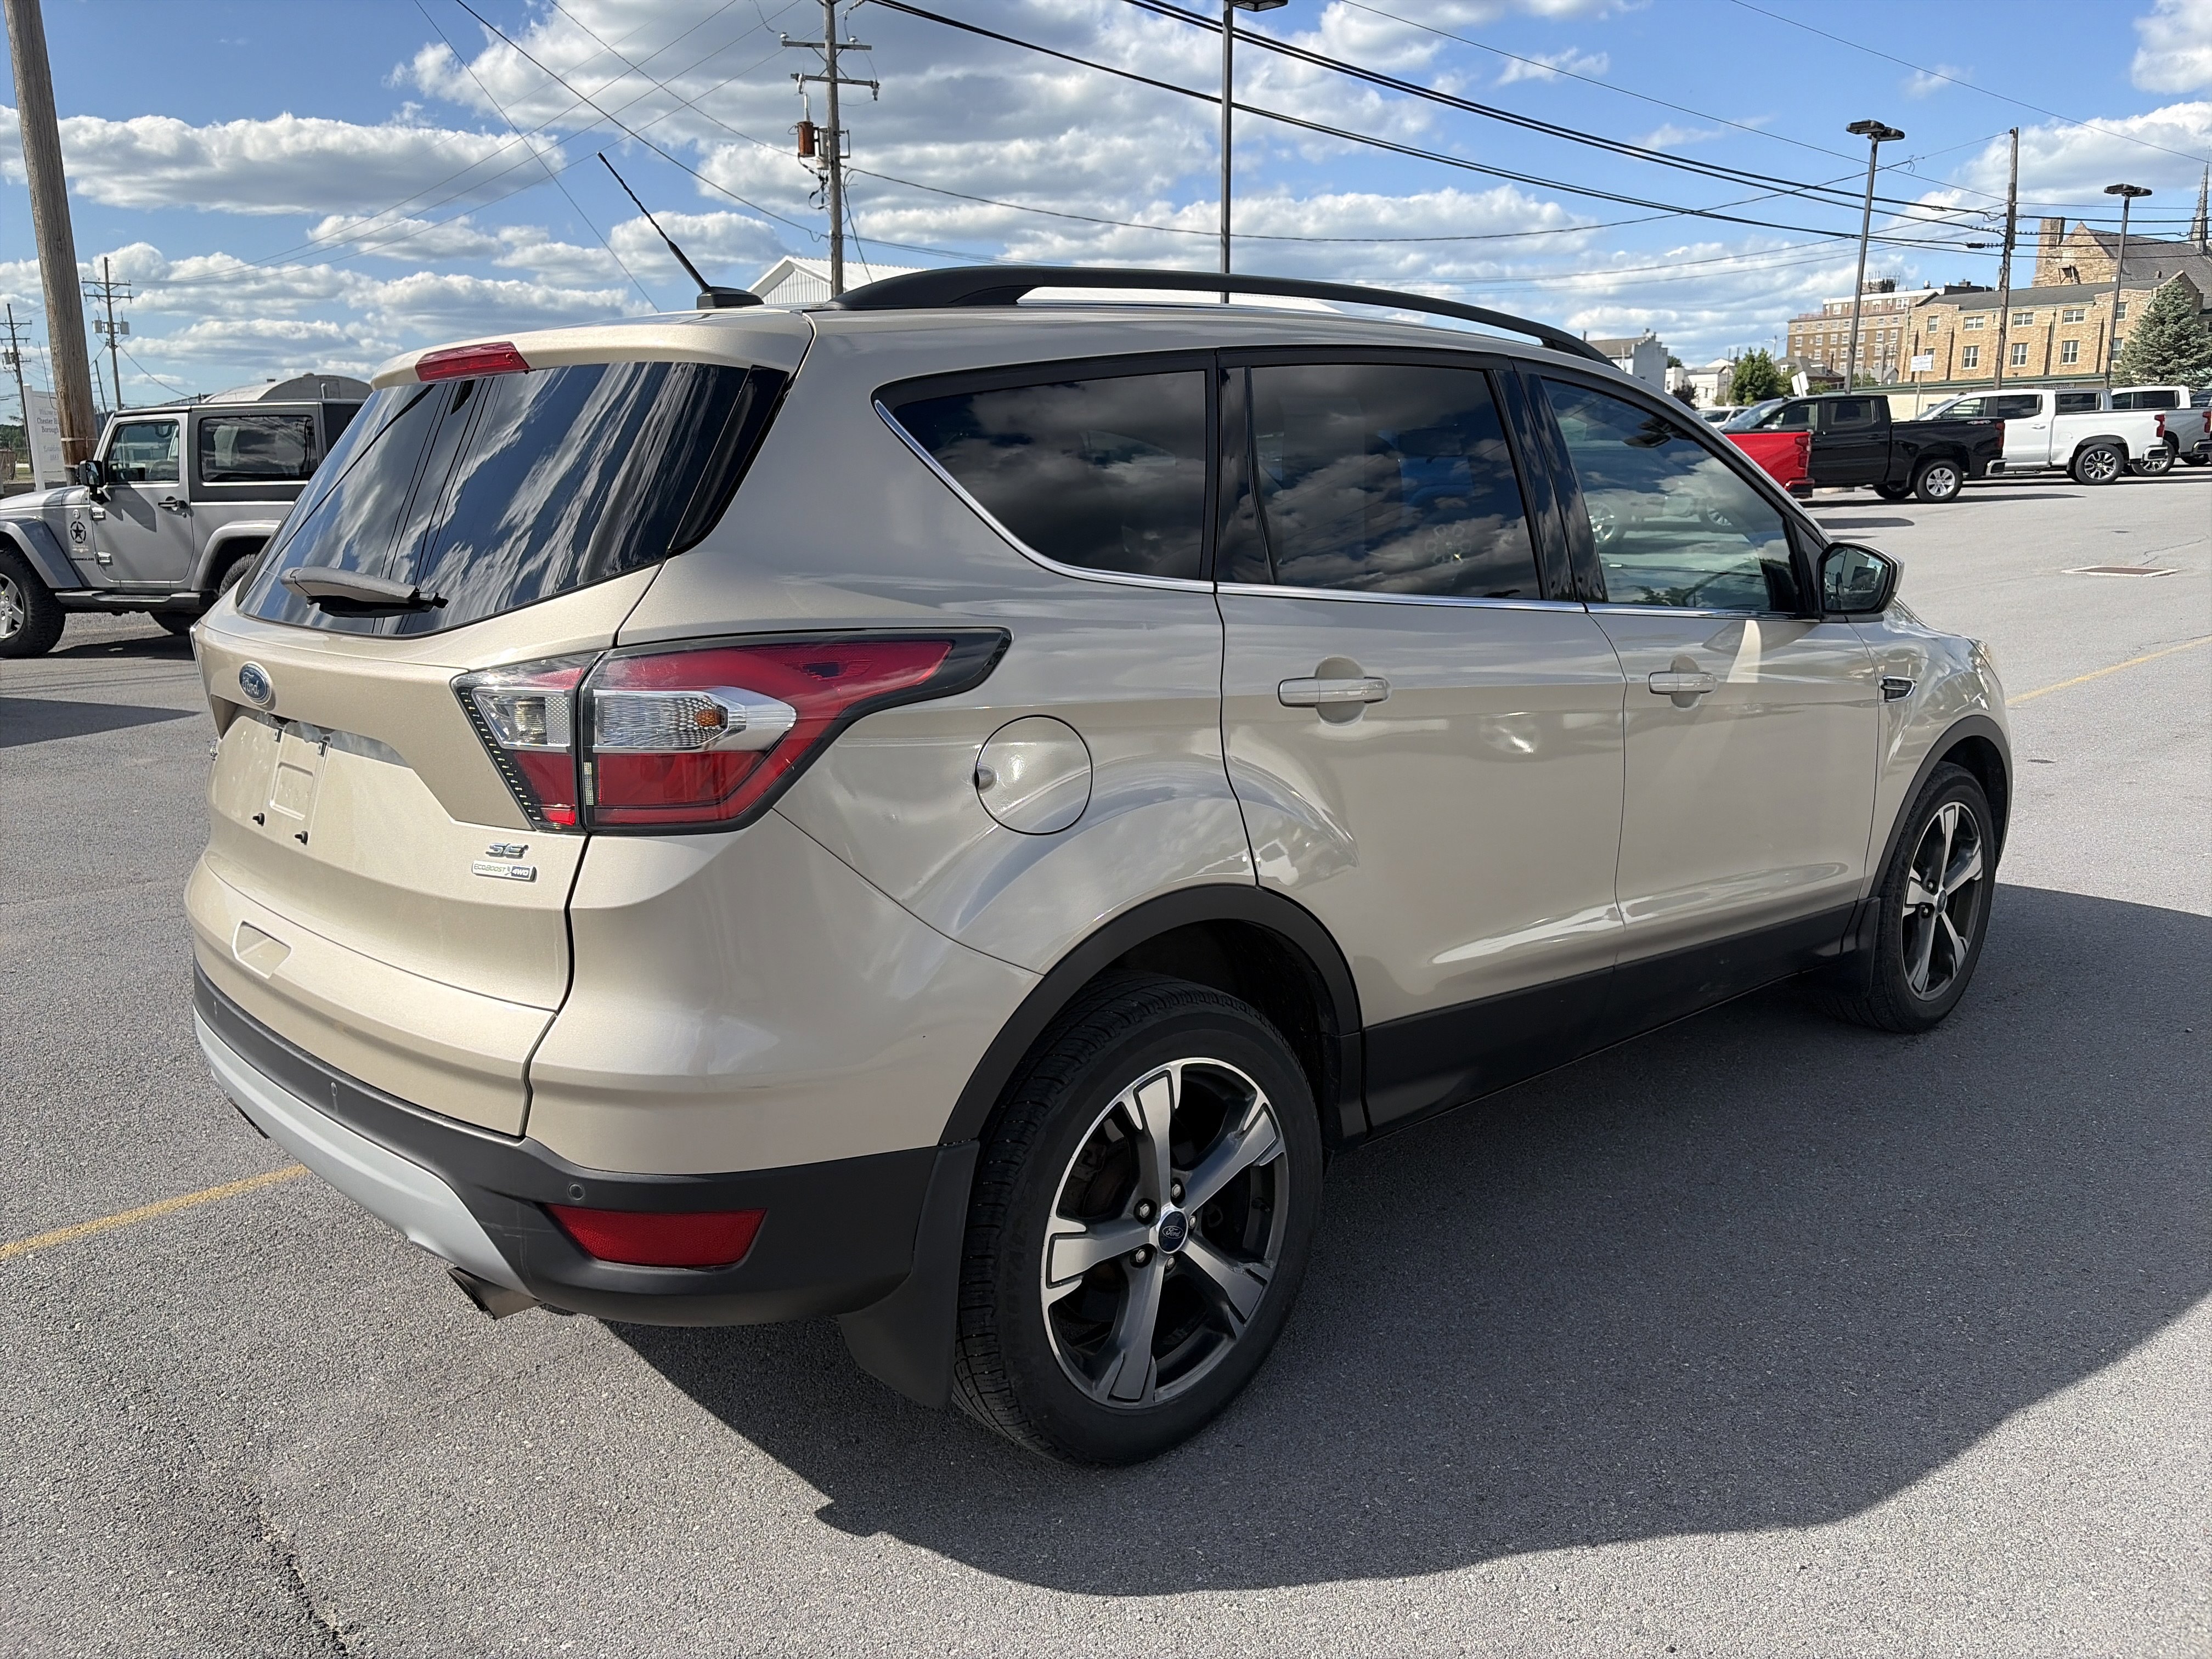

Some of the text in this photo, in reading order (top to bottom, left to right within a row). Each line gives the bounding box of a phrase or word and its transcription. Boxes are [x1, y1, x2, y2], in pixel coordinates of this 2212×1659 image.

[242, 672, 259, 696] Ford
[486, 843, 528, 859] SE
[511, 868, 529, 877] 4WD
[1166, 1227, 1181, 1237] Ford
